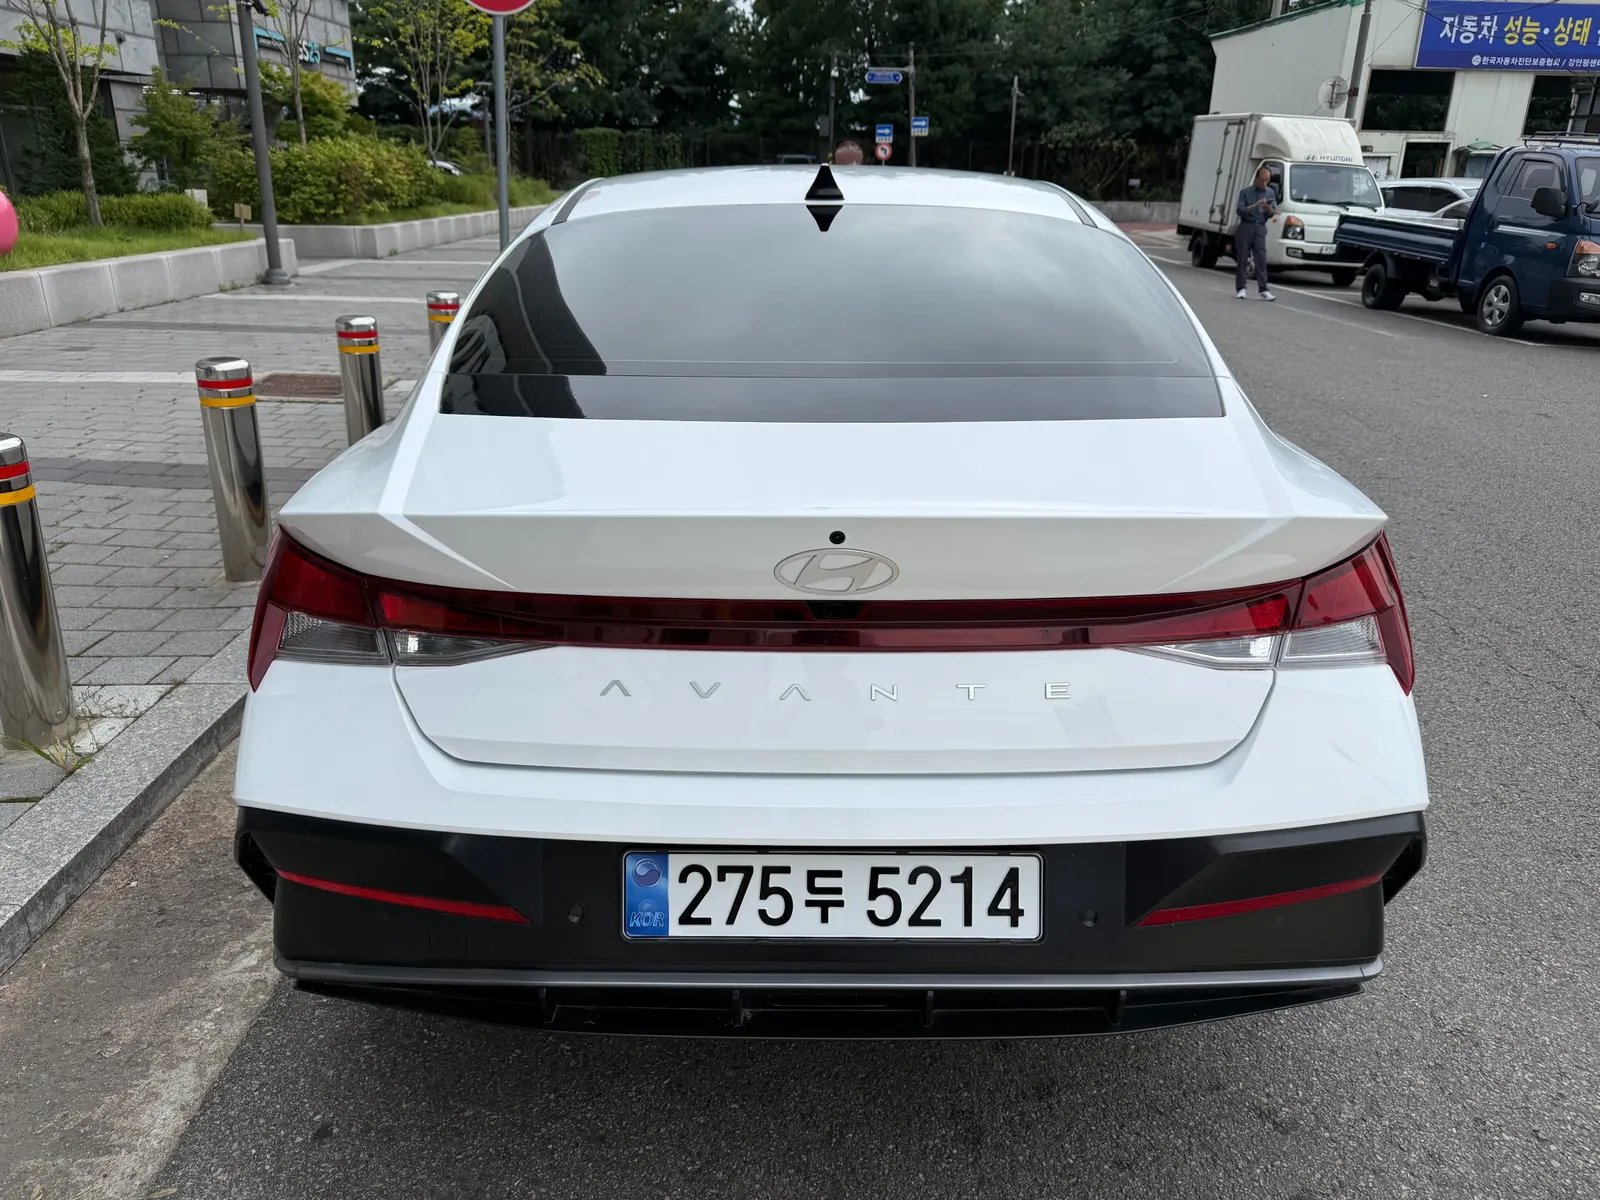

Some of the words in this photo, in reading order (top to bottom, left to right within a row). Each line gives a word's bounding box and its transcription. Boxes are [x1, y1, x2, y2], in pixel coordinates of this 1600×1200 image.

[1439, 15, 1498, 44] 자동차
[1319, 155, 1353, 163] HYUNDAI
[600, 679, 1071, 701] AVANTE
[678, 864, 845, 927] 275두
[866, 866, 1025, 928] 5214
[629, 911, 665, 927] KOR
